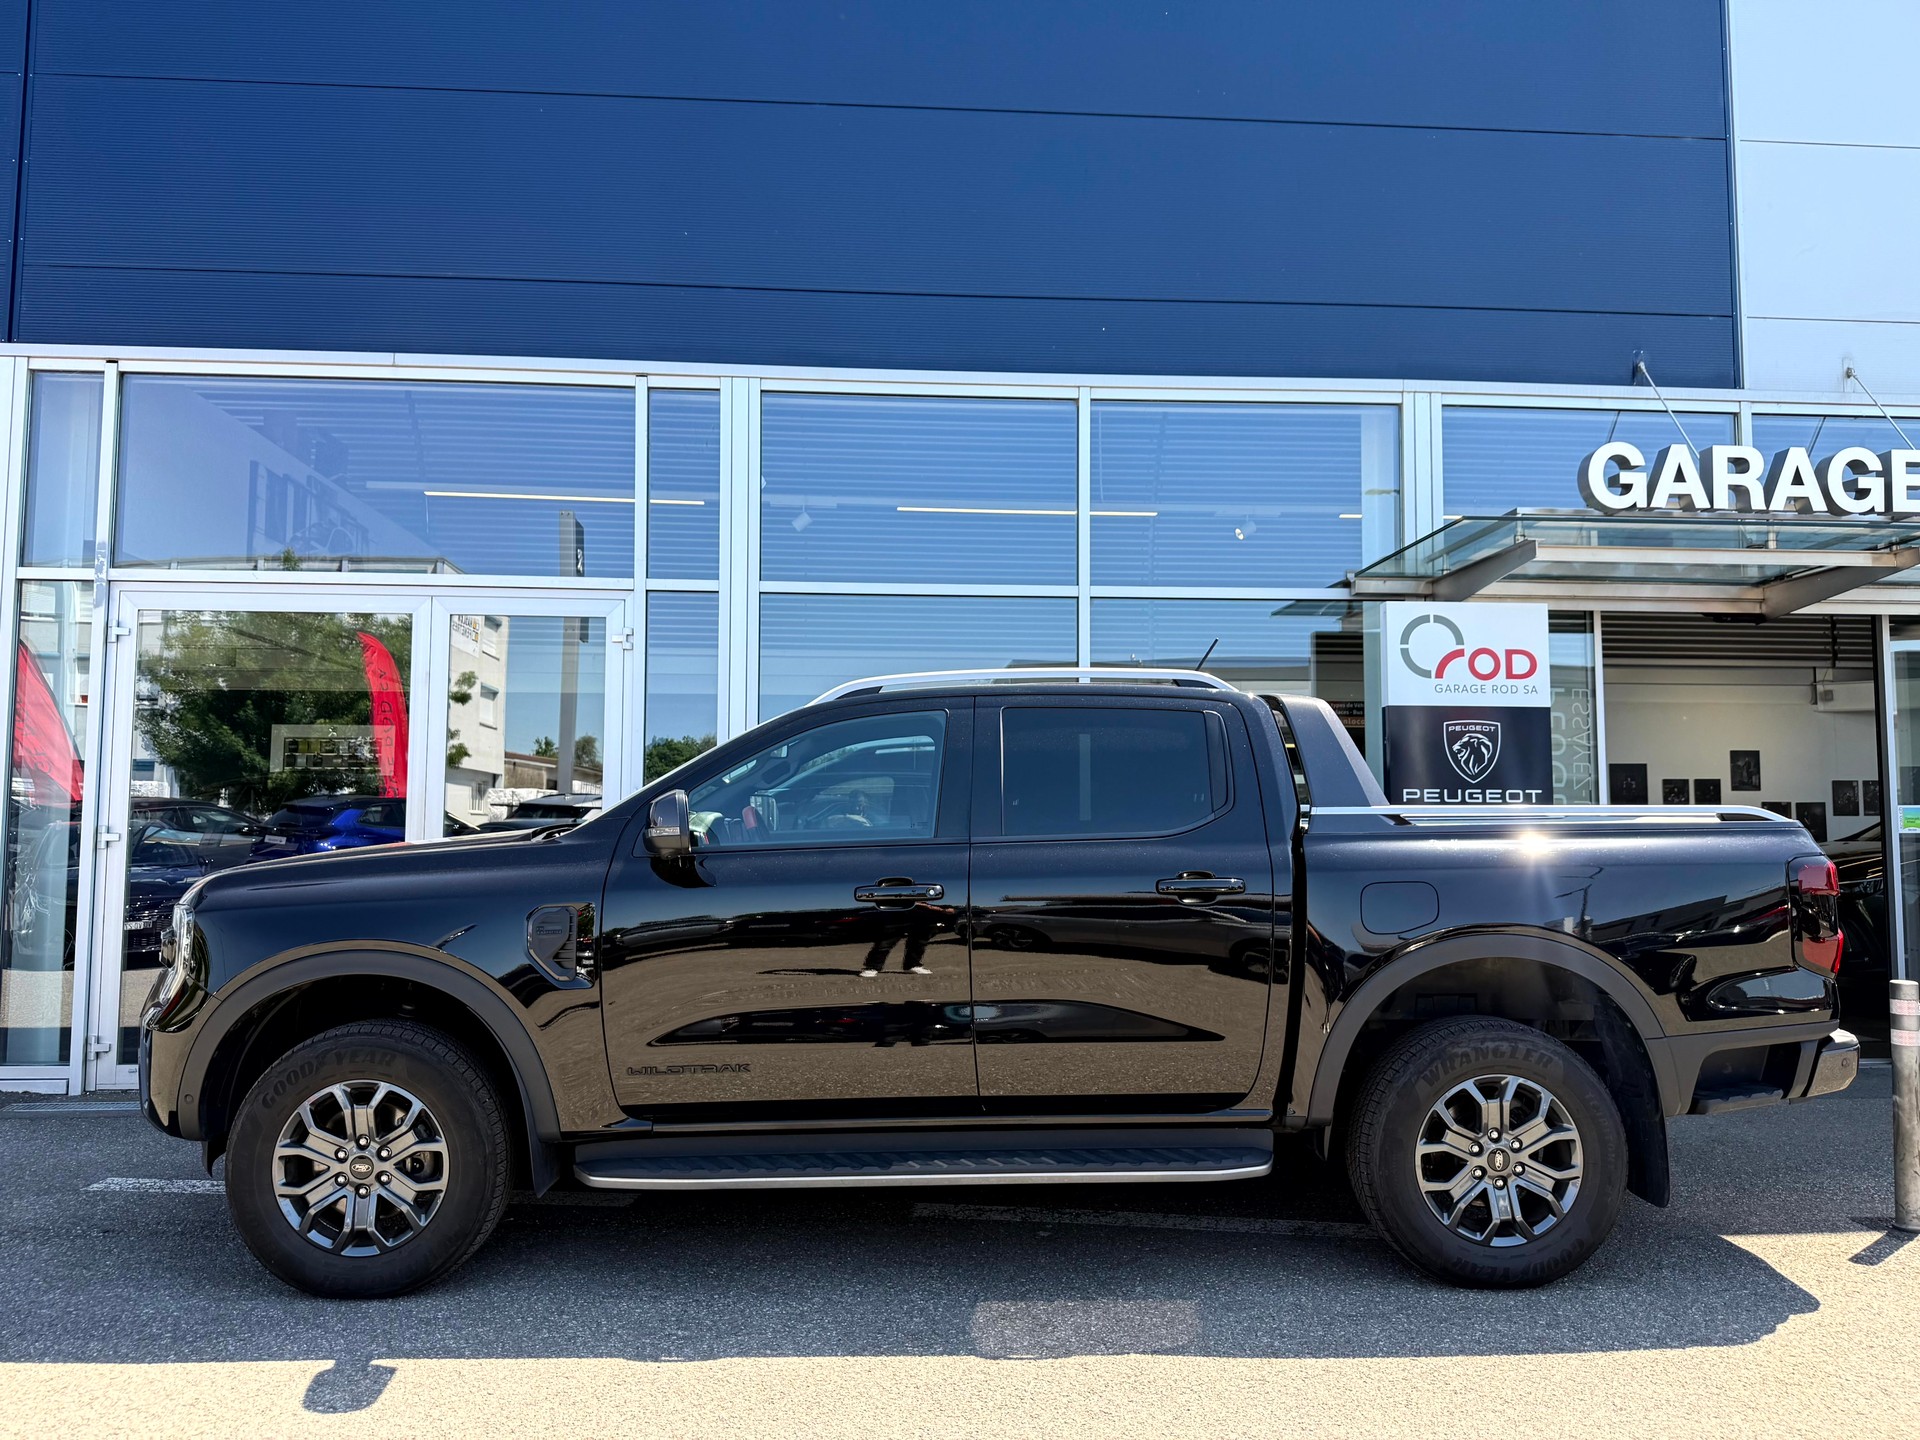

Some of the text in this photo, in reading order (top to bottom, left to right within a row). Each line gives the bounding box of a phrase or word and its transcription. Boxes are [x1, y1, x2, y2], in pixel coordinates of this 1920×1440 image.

[1584, 441, 1920, 514] GARAGE
[1434, 683, 1538, 694] GARAGE ROD SA
[1403, 788, 1542, 803] PEUGEOT
[626, 1063, 751, 1076] WILDTRAK
[1421, 1046, 1554, 1088] WRANGLER
